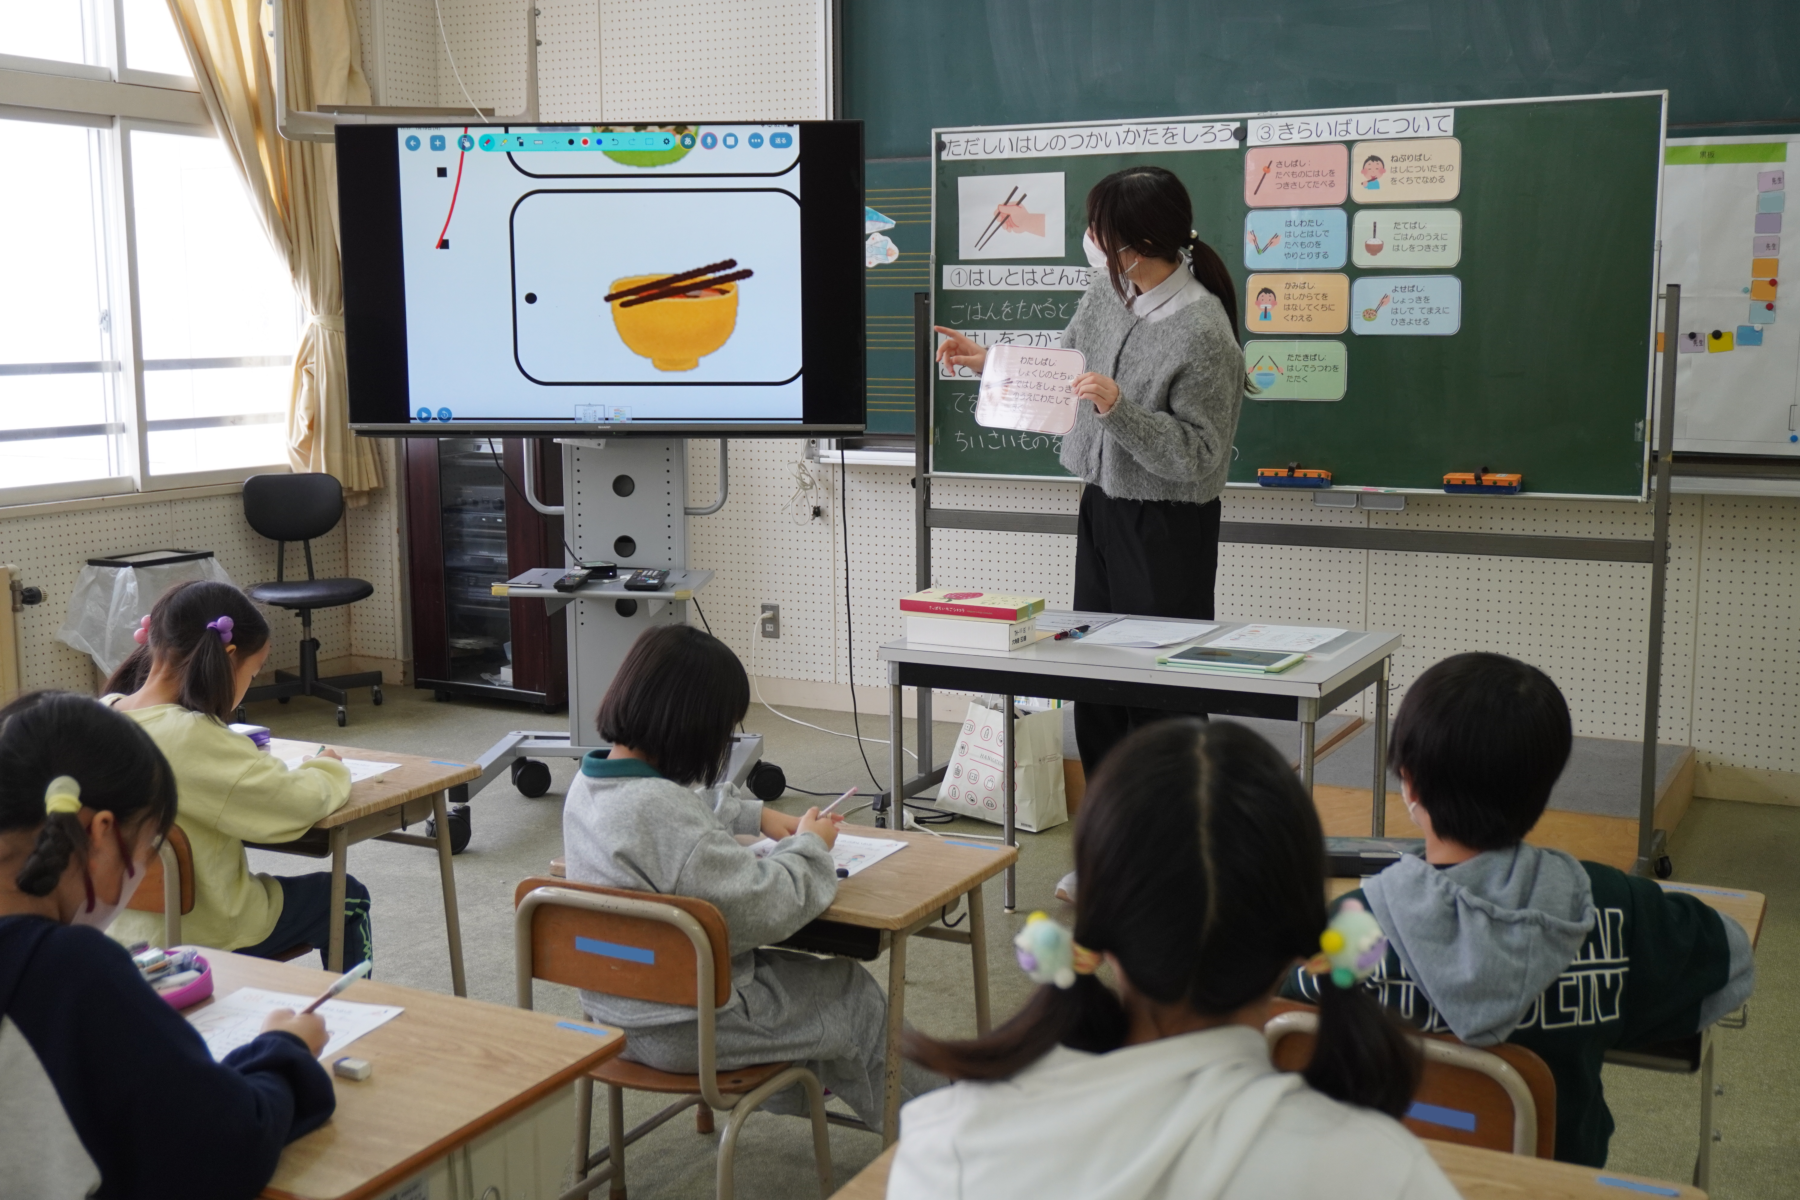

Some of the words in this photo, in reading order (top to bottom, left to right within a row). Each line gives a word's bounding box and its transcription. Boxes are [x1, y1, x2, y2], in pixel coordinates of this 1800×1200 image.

[1257, 115, 1450, 142] ③きらいばしについて
[946, 124, 1233, 157] ただしいはしのつかいかたをしろう
[1390, 164, 1454, 174] はしについたもの
[1275, 169, 1335, 180] たべものにはしを
[1275, 180, 1336, 190] つきさしてたべる
[1390, 175, 1446, 185] をくちでなめる
[1284, 230, 1330, 239] はしとはしで
[1393, 232, 1448, 242] ごはんのうえに
[1284, 240, 1321, 249] たべものを
[1392, 243, 1448, 253] はしをつきさす
[1284, 251, 1329, 260] やりとりする
[950, 268, 1099, 288] ①はしとはどんな
[1284, 292, 1329, 301] はしからてを
[1391, 295, 1431, 304] しょっきを
[1283, 303, 1335, 312] はなしてくちに
[1283, 314, 1313, 323] くわえる
[1391, 317, 1430, 326] ひきよせる
[1286, 364, 1339, 373] はしでうつわを
[1018, 369, 1082, 381] しょくじのとちゅ
[1286, 375, 1308, 383] たたく
[1015, 380, 1073, 393] ではしをしょっき
[1012, 391, 1071, 406] のうえにわたして
